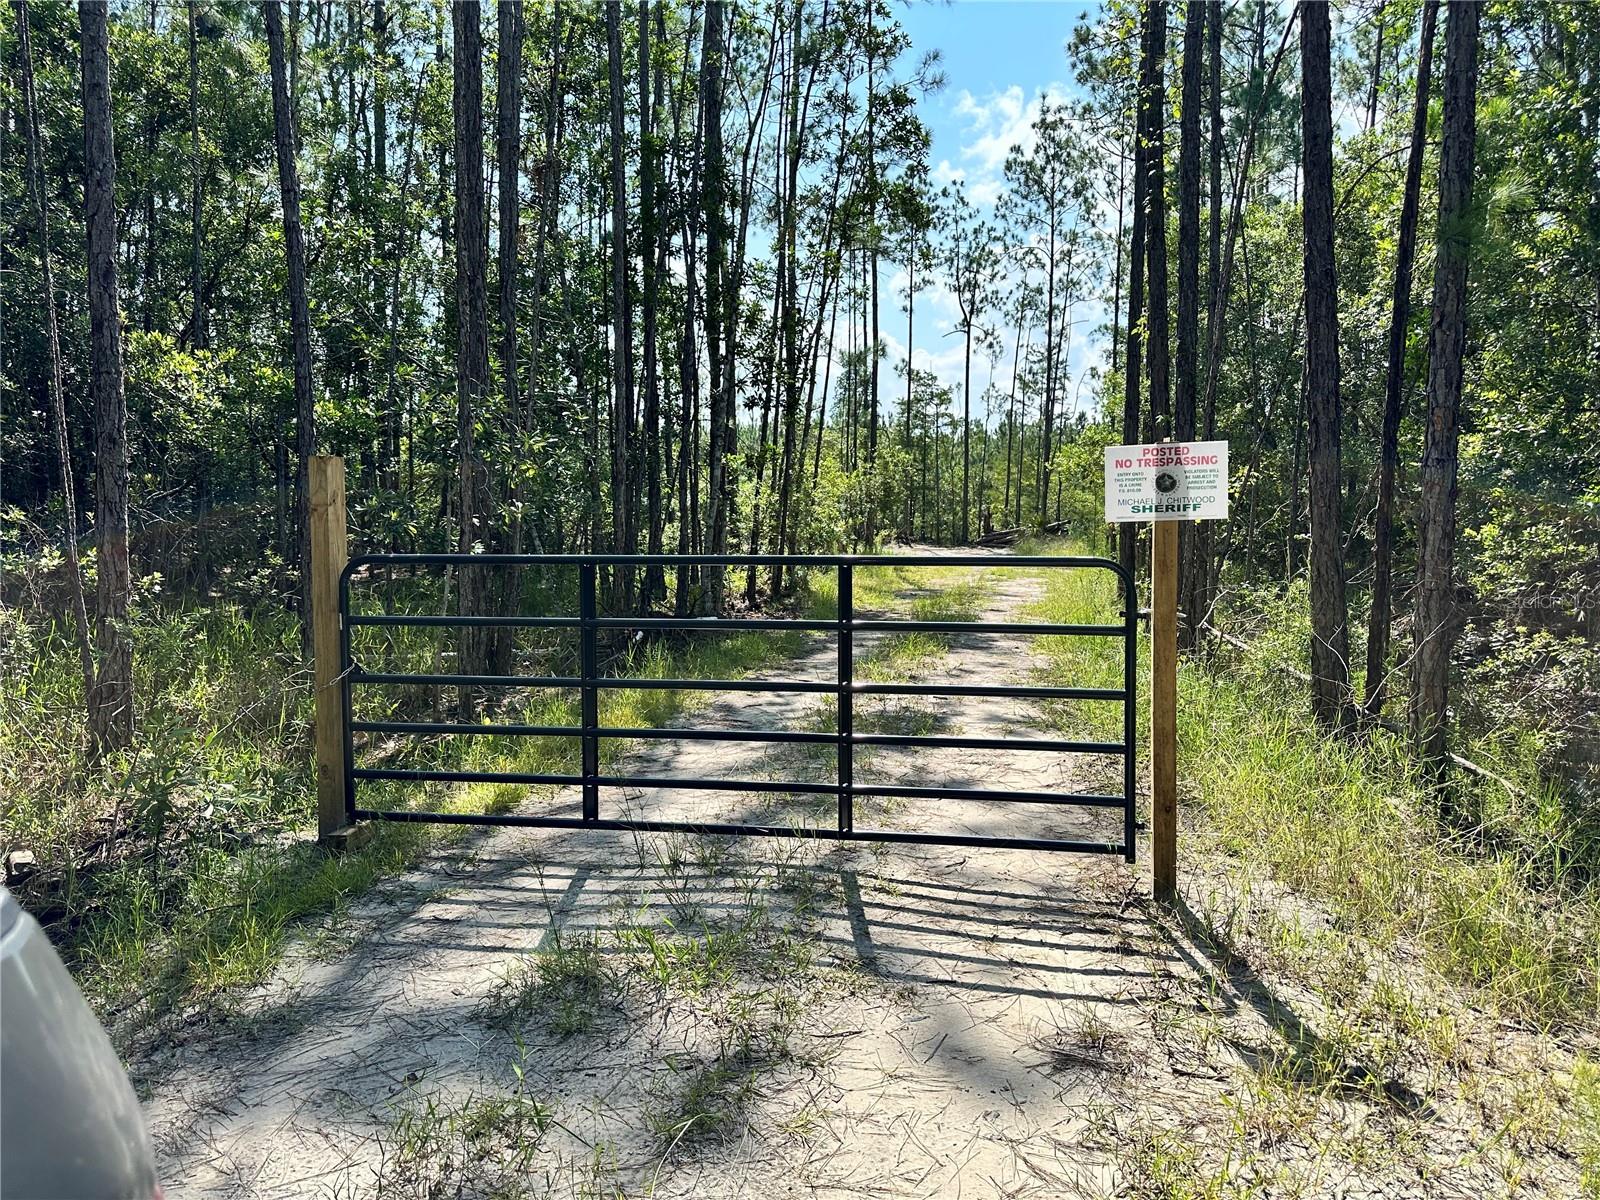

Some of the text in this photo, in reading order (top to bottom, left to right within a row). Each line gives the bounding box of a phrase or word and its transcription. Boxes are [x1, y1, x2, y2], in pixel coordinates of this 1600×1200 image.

[1142, 446, 1190, 457] POSTED
[1115, 455, 1218, 469] NO TRESPASSING
[1117, 497, 1155, 506] MICHAEL
[1166, 496, 1215, 505] CHITWOOD
[1131, 503, 1202, 513] SHERIFF
